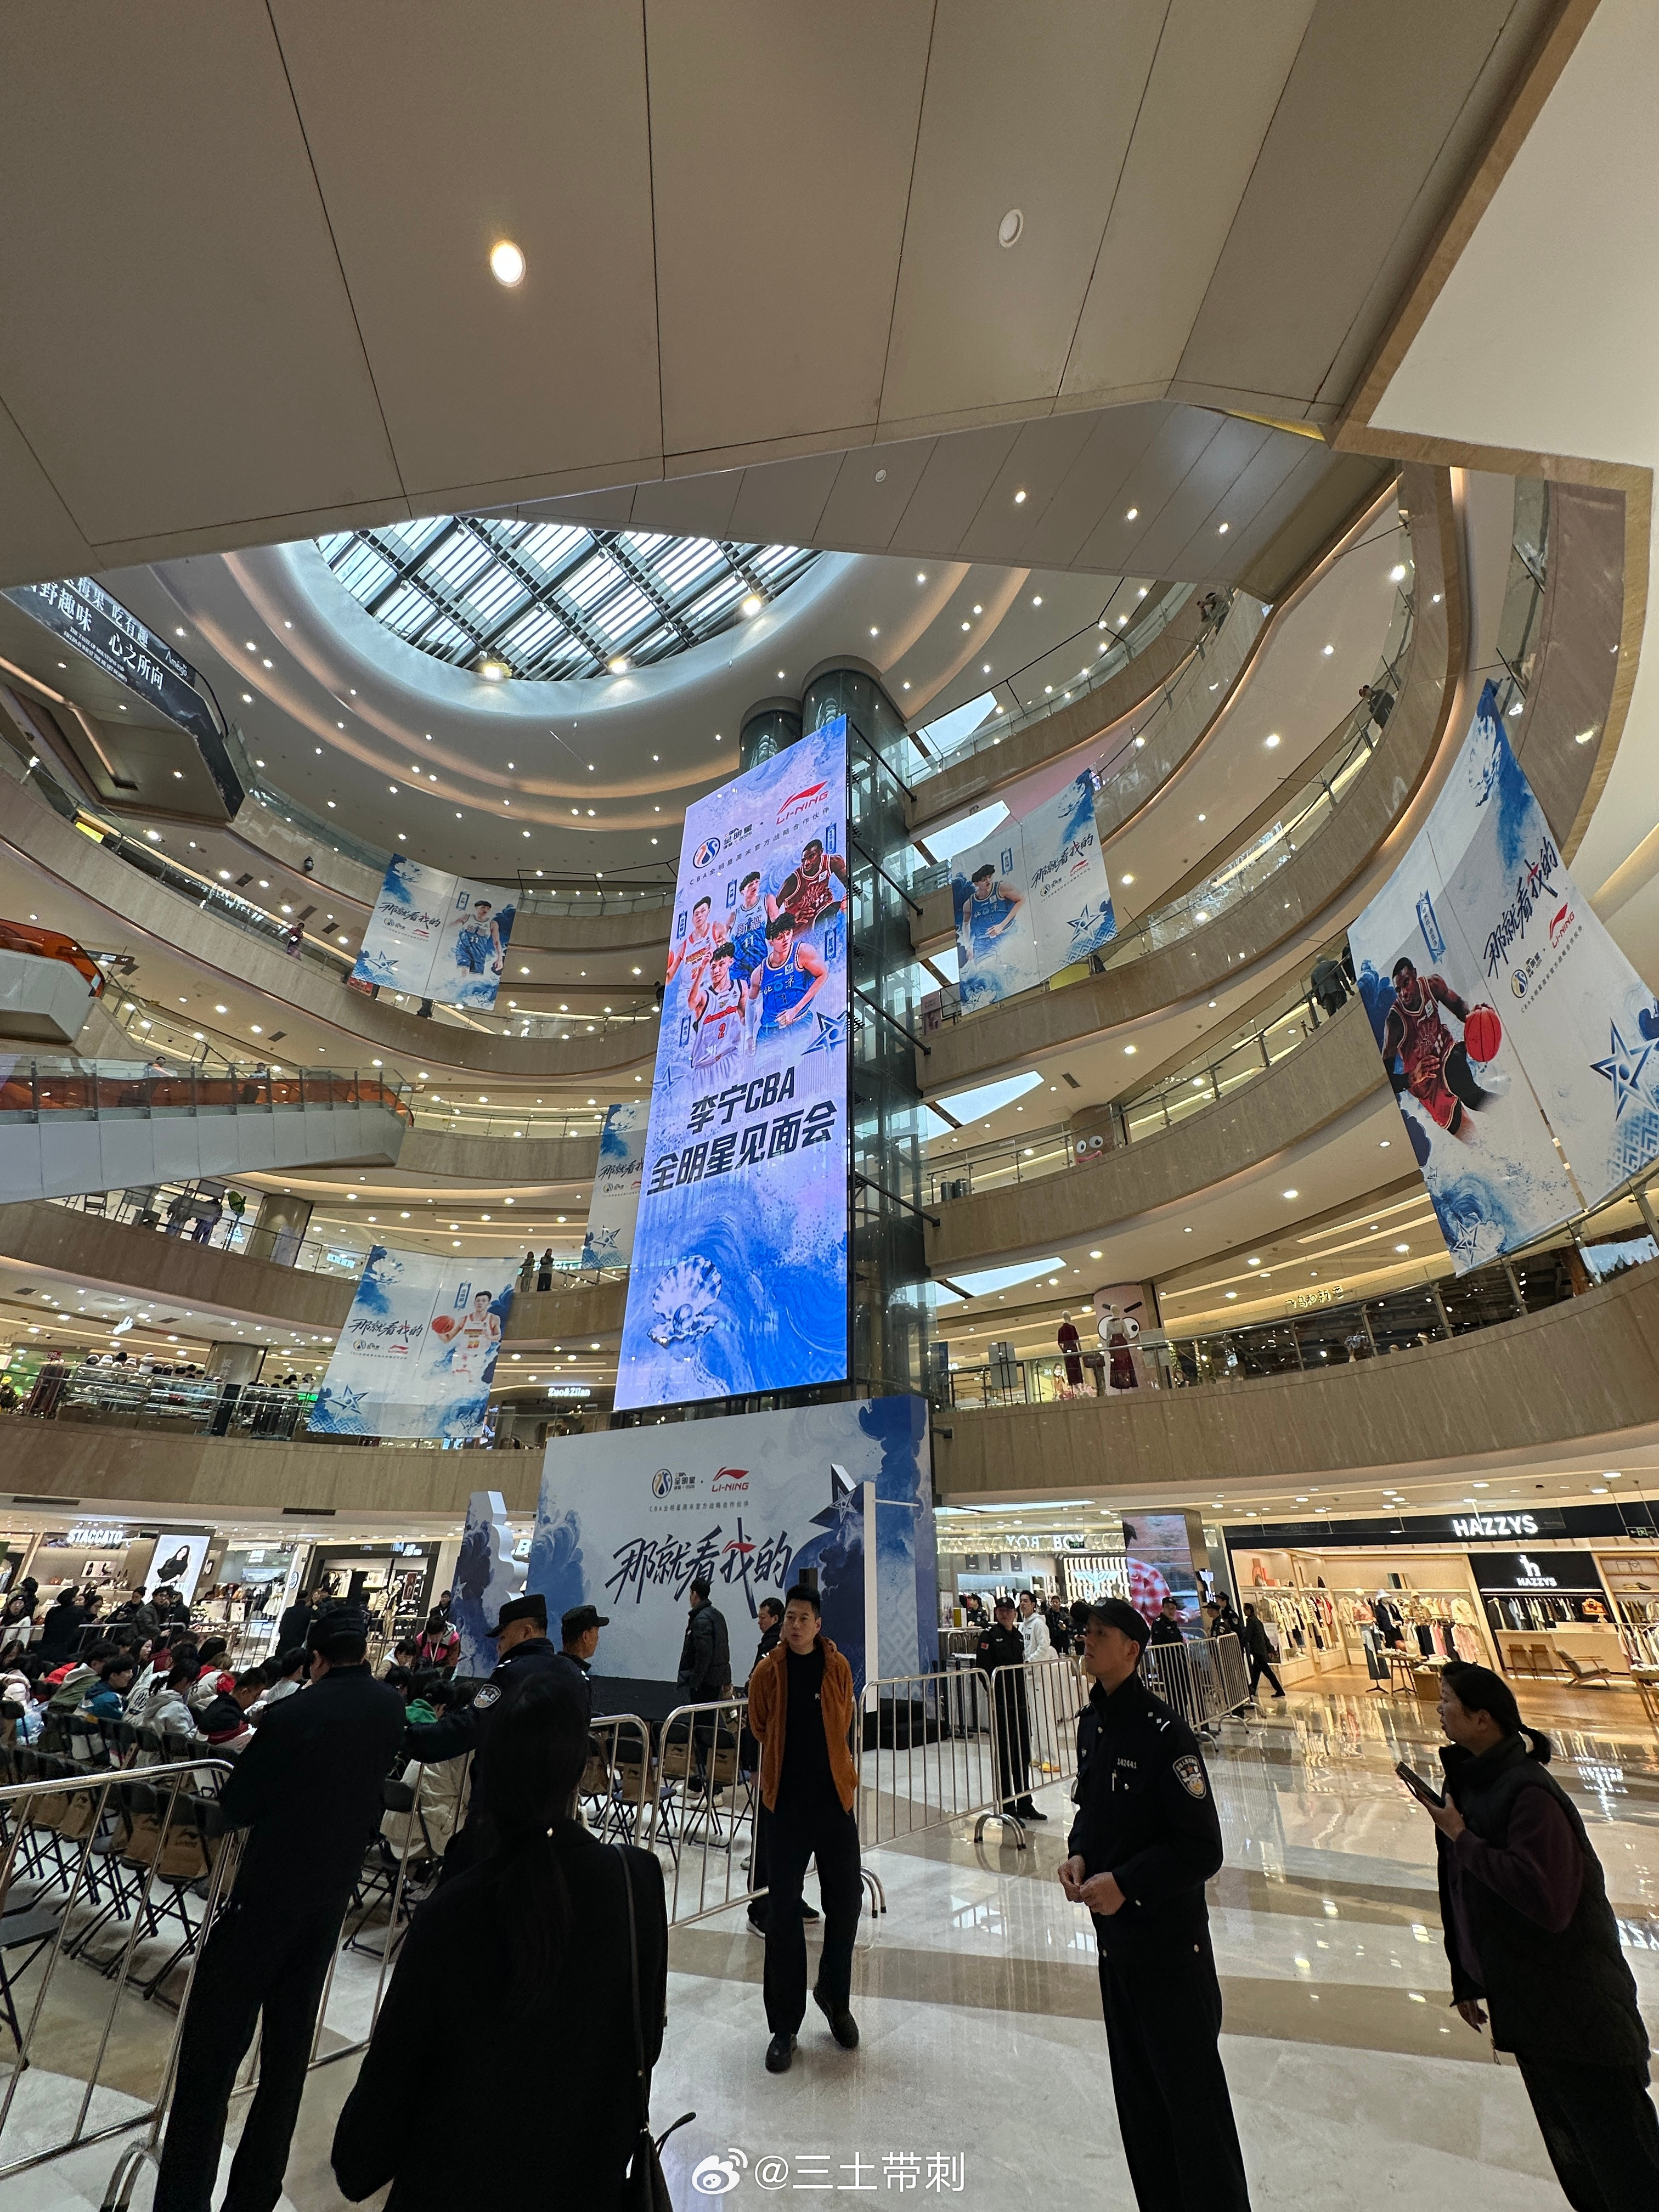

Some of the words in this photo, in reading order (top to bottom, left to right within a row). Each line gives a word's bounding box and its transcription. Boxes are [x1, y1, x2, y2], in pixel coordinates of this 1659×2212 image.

[31, 582, 92, 631] 野趣味
[108, 632, 163, 691] 心之所向
[112, 604, 149, 648] 吃有趣
[776, 791, 829, 825] LI-NING
[378, 901, 441, 930] 那就看我的
[1483, 836, 1558, 979] 那就看我的
[1552, 911, 1575, 949] LI-NING
[718, 1022, 726, 1040] 2
[687, 1066, 795, 1135] 李宁CBA
[647, 1099, 838, 1196] 全明星见面会
[348, 1318, 423, 1344] 那就看我的
[711, 1482, 749, 1492] LI-NING
[66, 1529, 125, 1544] STACCATO
[1452, 1515, 1538, 1537] HAZZYS
[605, 1517, 793, 1619] 那就看我的
[1516, 1577, 1558, 1587] HAZZYS
[1116, 1757, 1137, 1769] 142441
